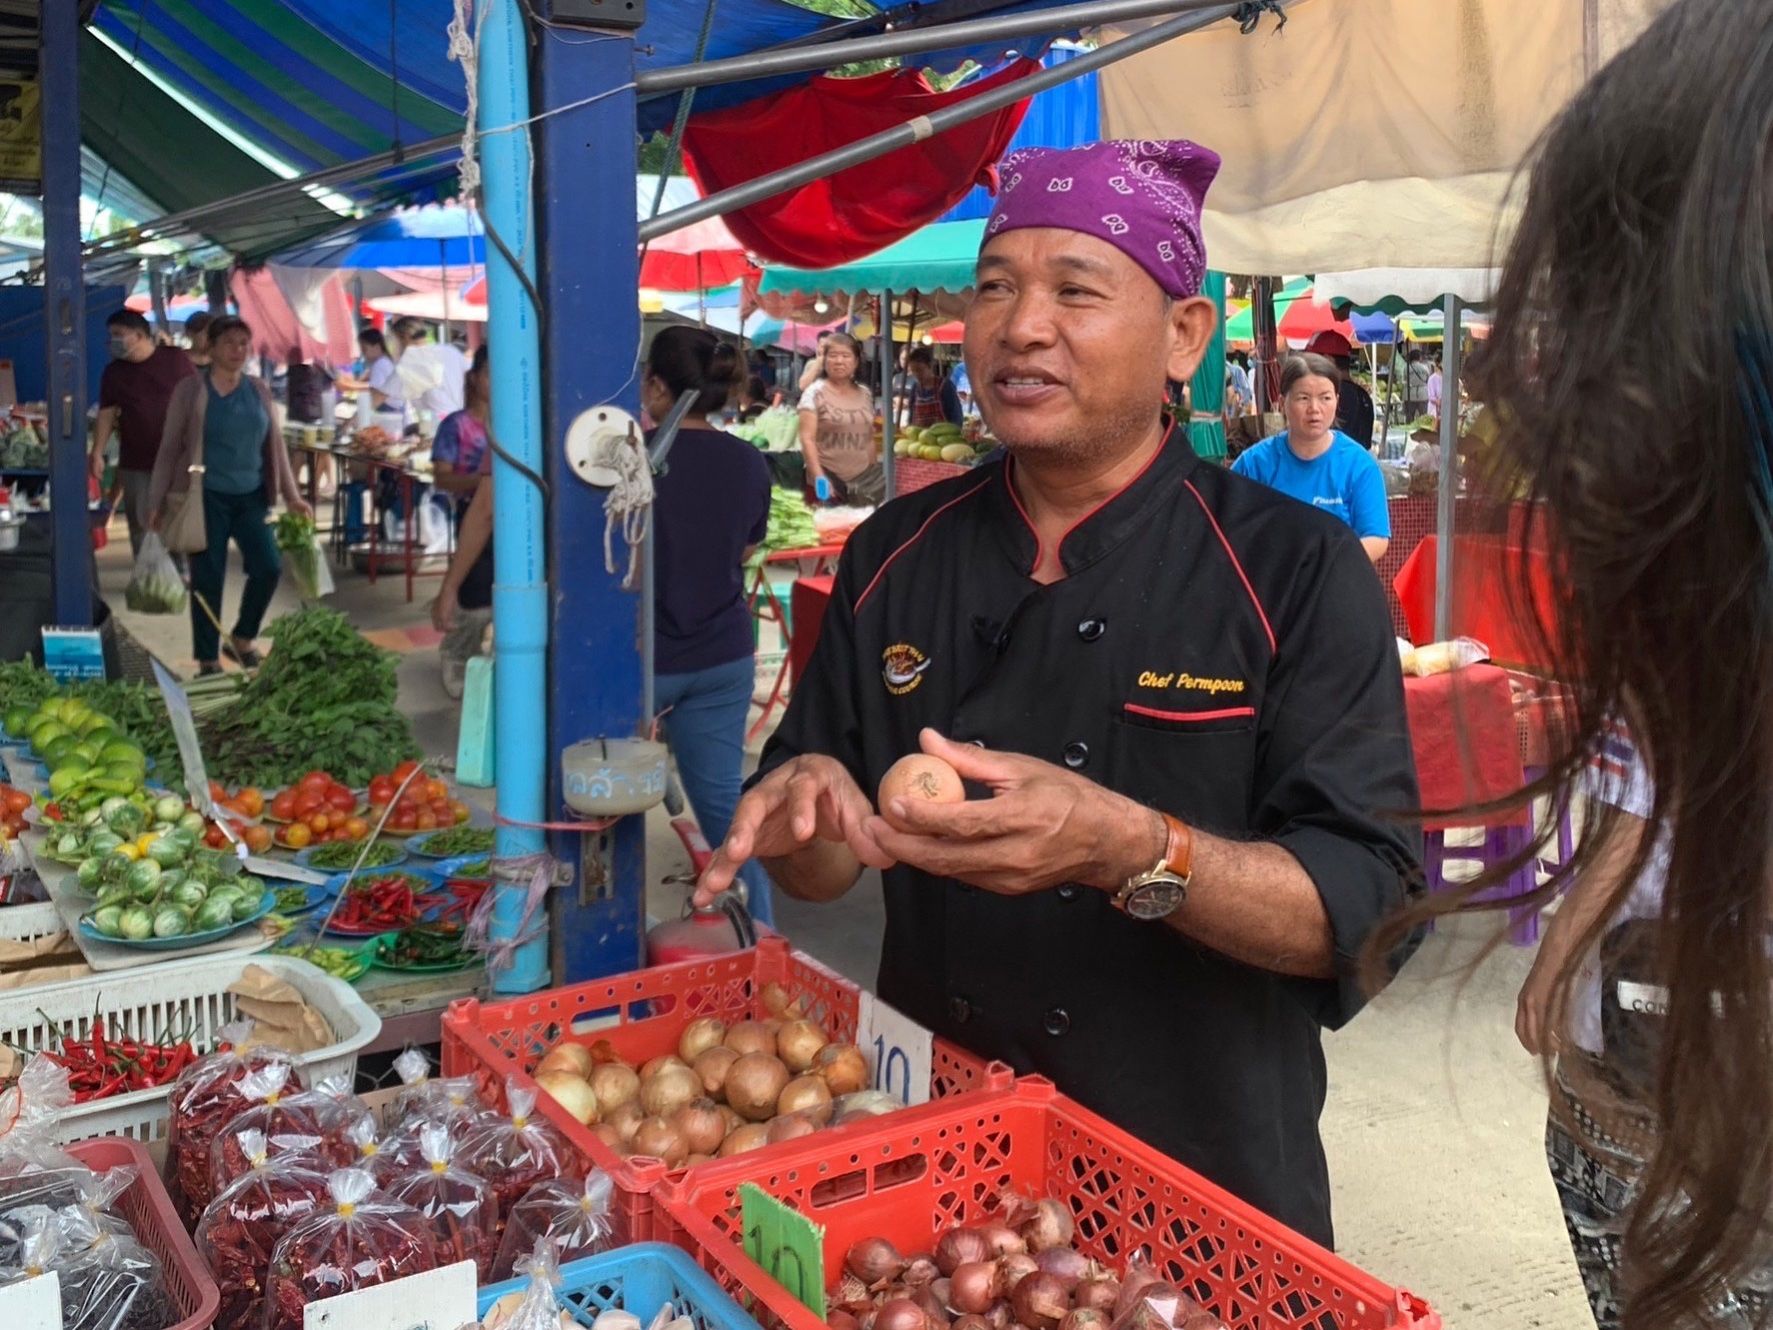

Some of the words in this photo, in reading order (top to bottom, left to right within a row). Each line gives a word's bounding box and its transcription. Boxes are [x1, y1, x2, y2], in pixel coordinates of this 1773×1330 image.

[1138, 671, 1174, 688] Chef
[1176, 673, 1245, 695] Permpoon
[873, 1033, 910, 1107] 10
